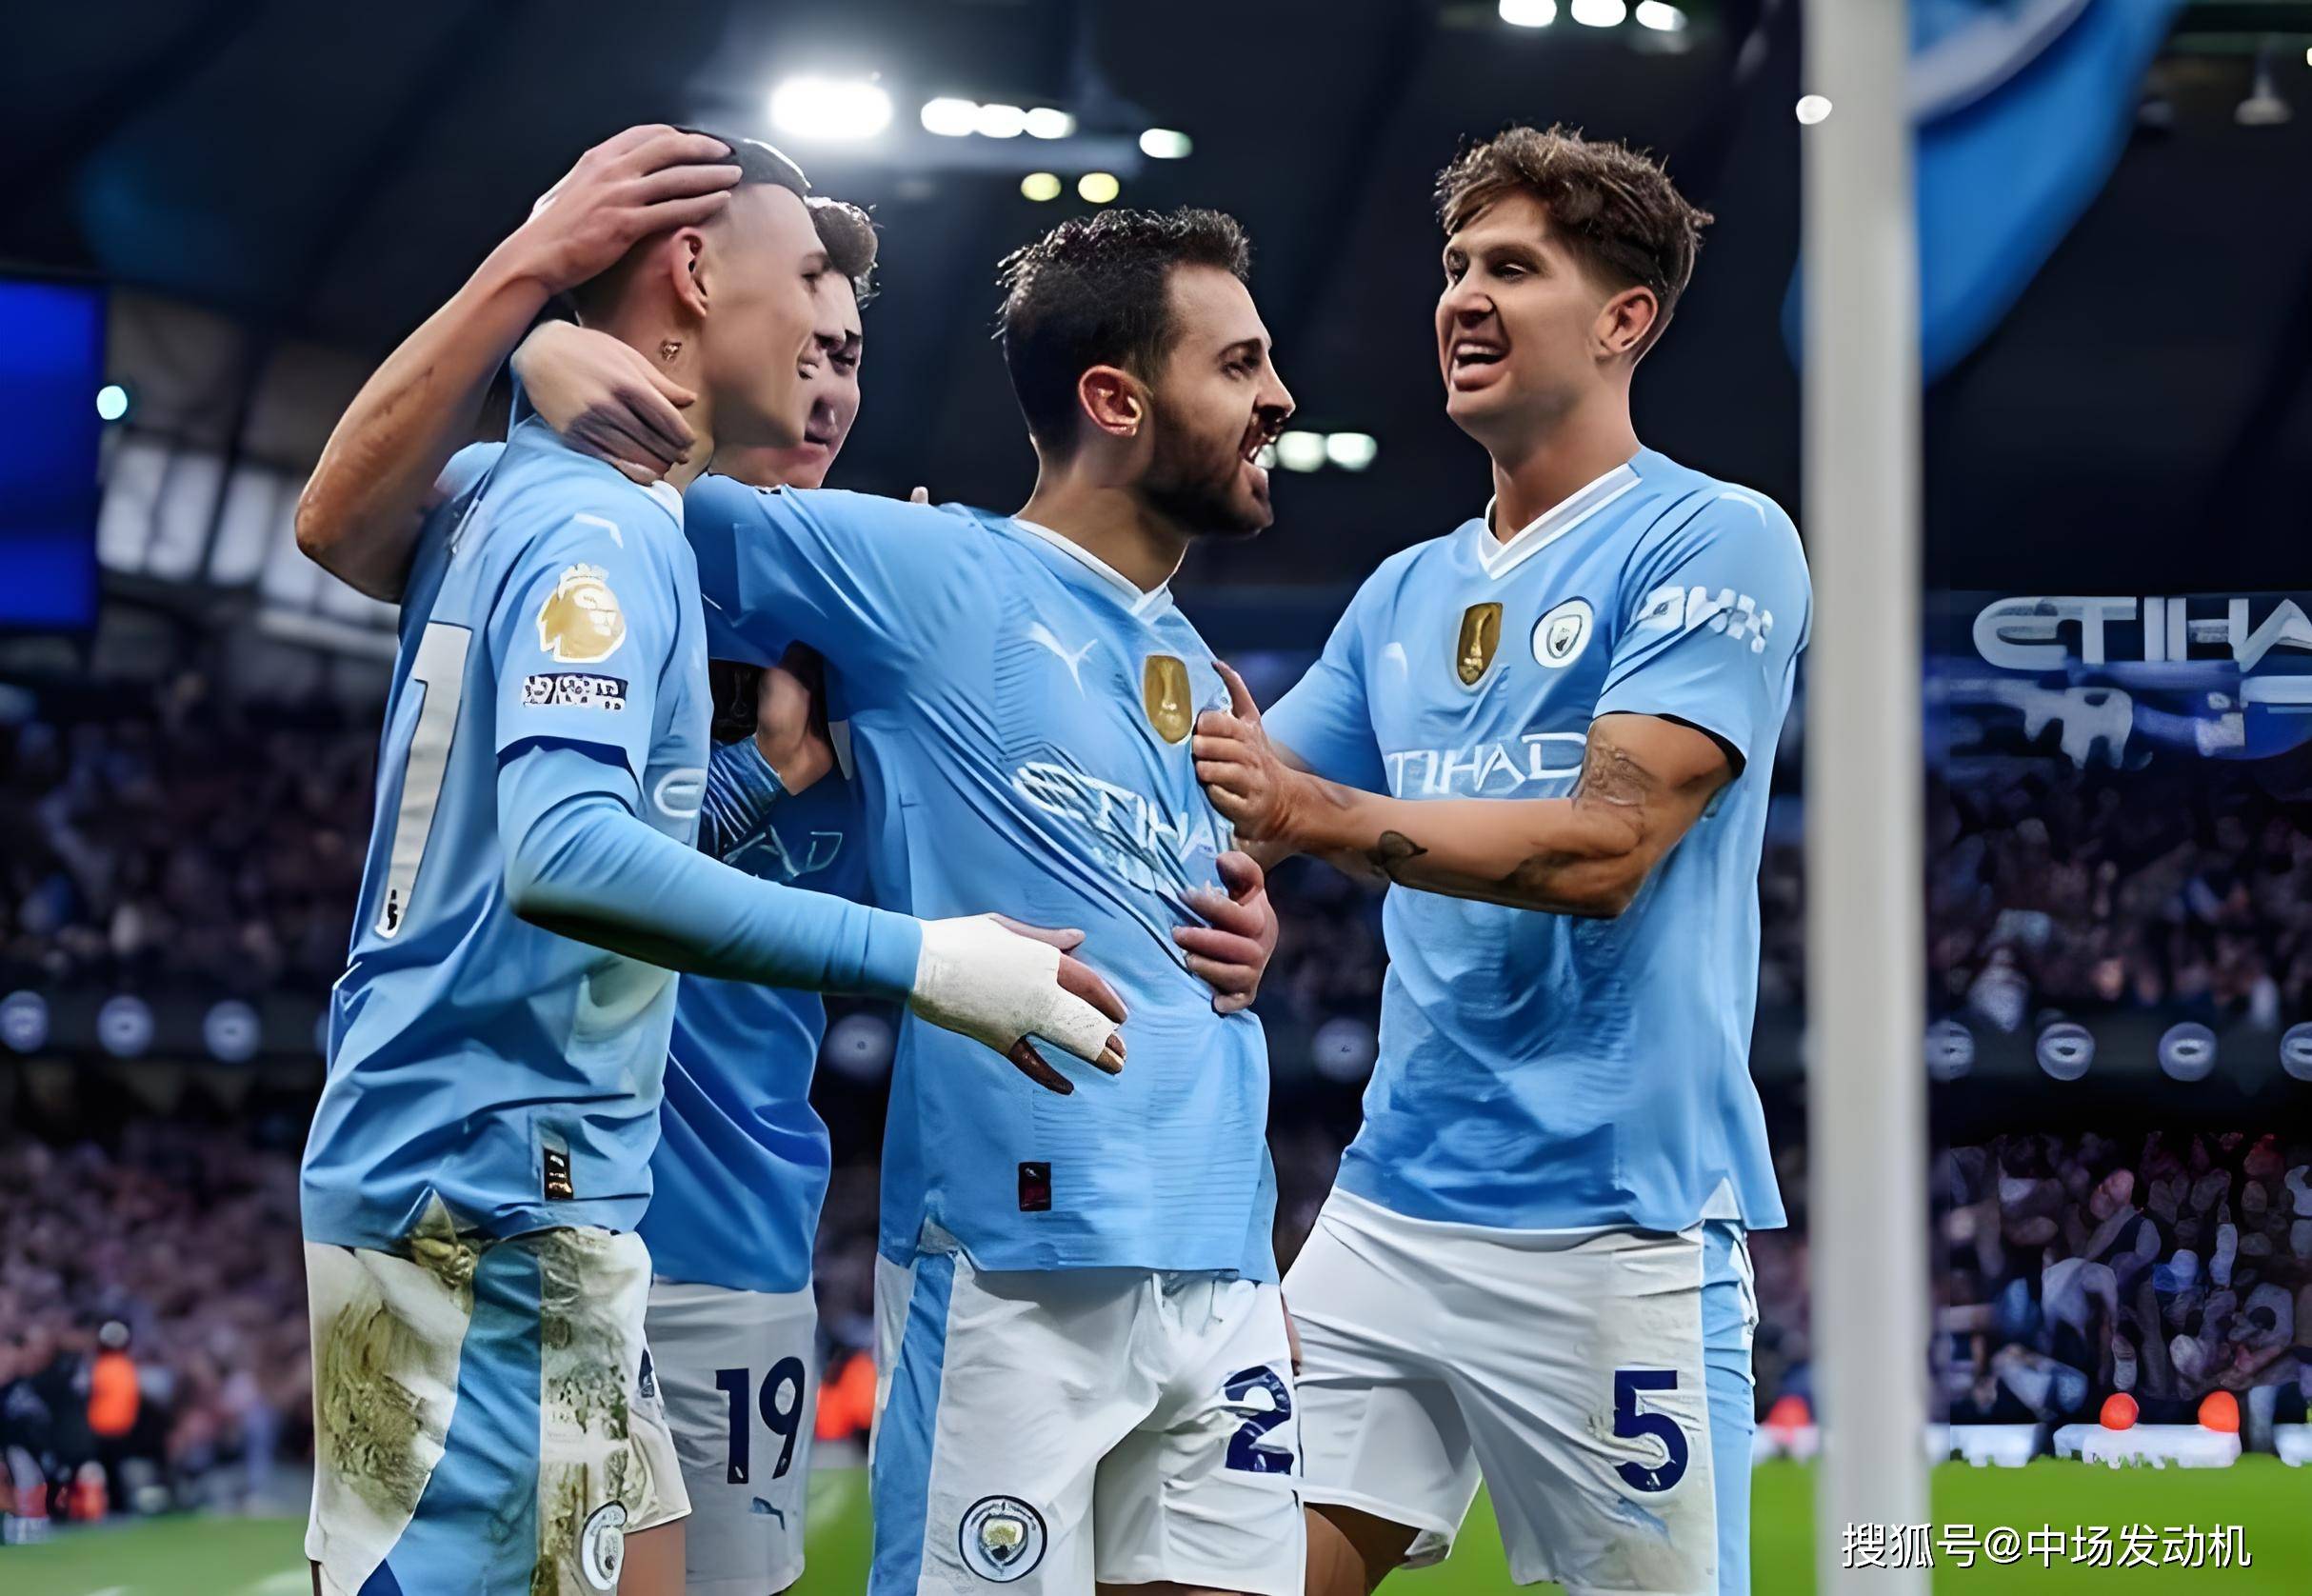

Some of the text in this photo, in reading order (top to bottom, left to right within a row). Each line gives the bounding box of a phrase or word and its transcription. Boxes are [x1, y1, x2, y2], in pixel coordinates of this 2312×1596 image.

[1385, 731, 1588, 798] TIHAD
[715, 1356, 806, 1485] 19
[1613, 1369, 1689, 1493] 5
